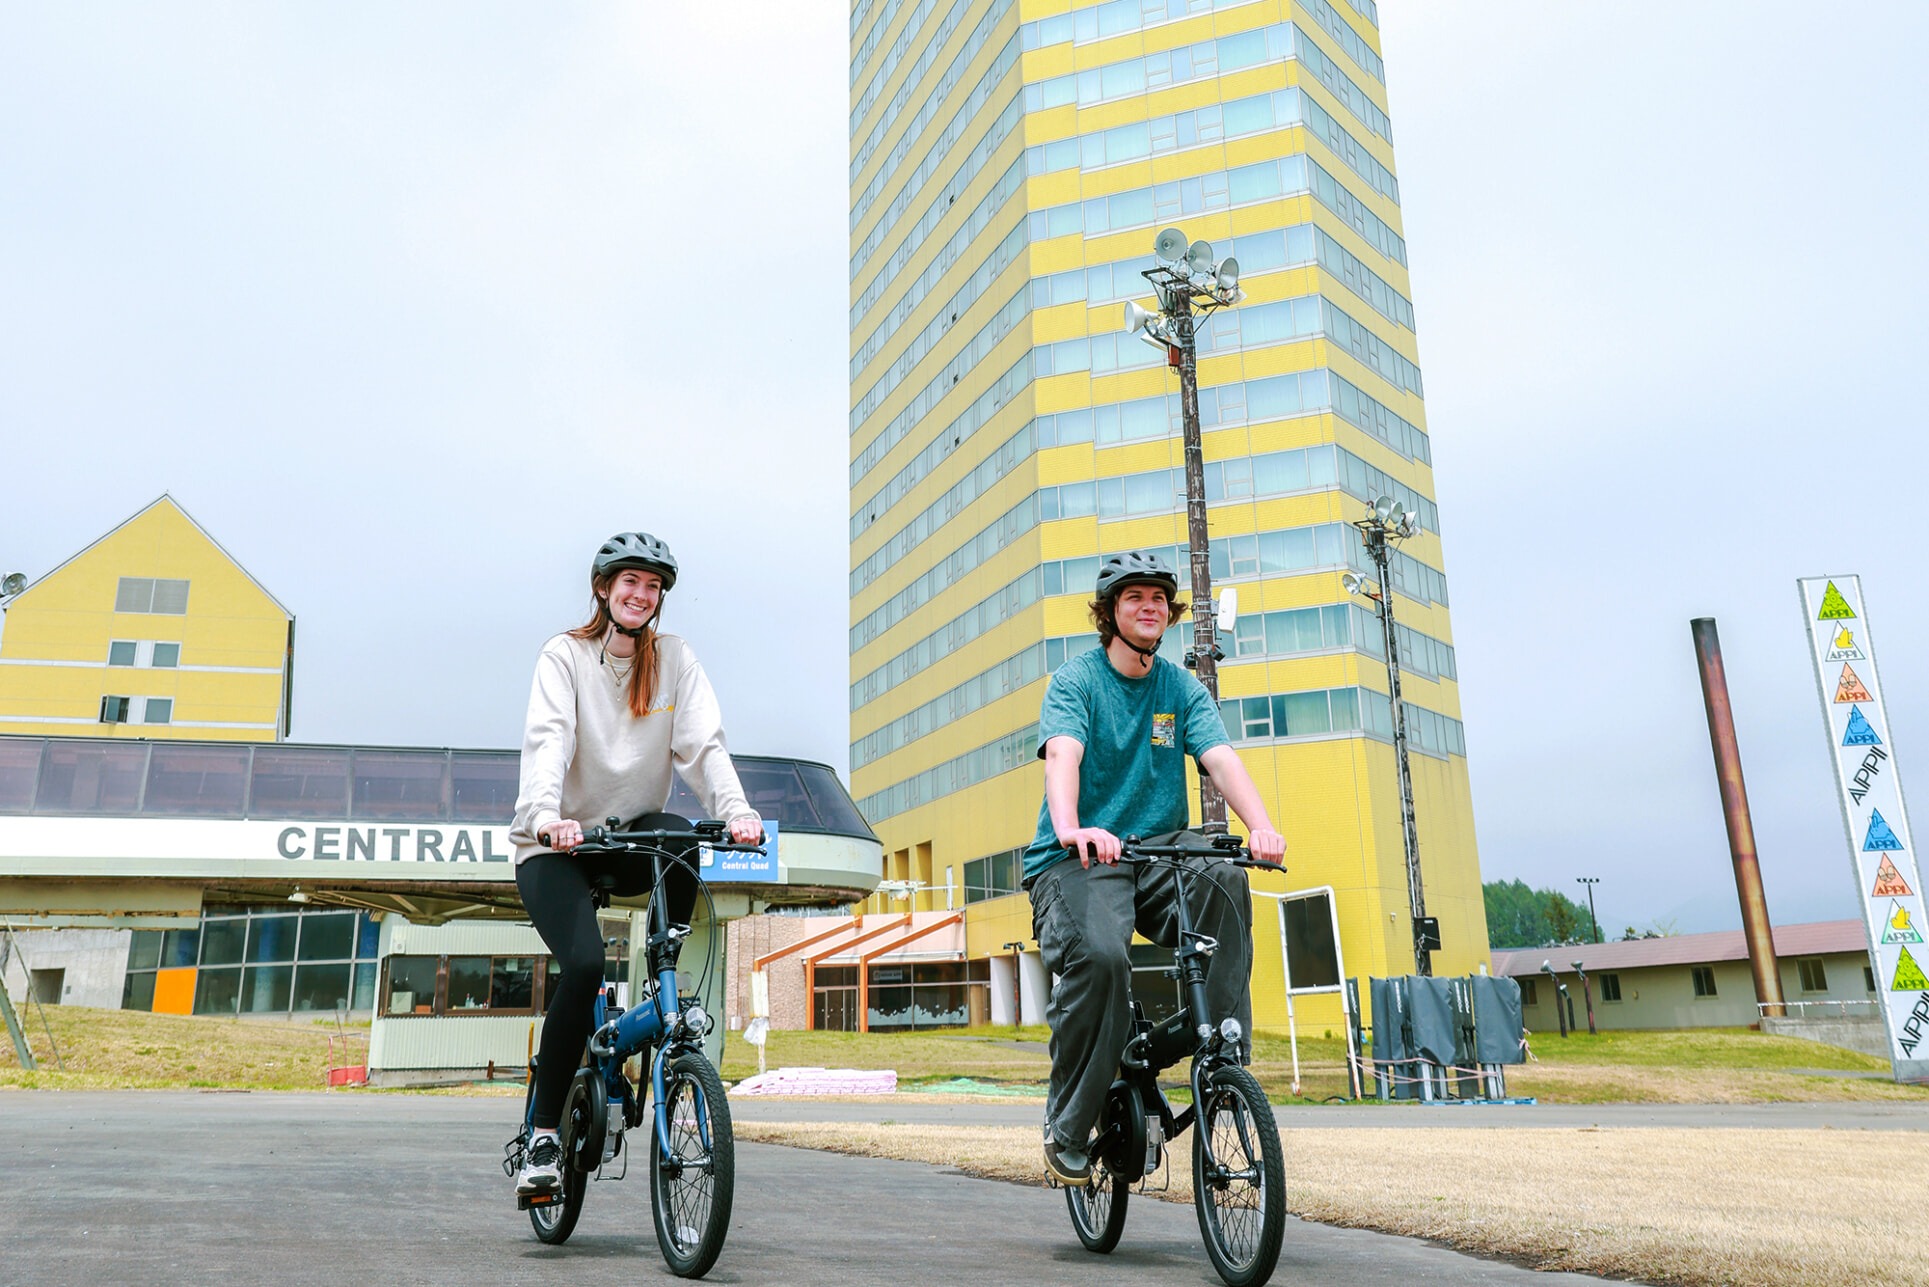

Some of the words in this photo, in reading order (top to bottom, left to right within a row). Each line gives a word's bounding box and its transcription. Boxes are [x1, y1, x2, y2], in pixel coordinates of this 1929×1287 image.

[1822, 609, 1850, 618] APPI
[1830, 650, 1858, 659] APPI
[1838, 691, 1867, 701] APPI
[1846, 735, 1875, 744] APPI
[1848, 745, 1888, 806] APPI
[277, 826, 509, 863] CENTRAL
[1867, 840, 1897, 849] APPI
[722, 861, 749, 870] Central
[750, 861, 769, 870] Quad
[1877, 885, 1906, 895] APPI
[1886, 932, 1916, 942] APPI
[1895, 980, 1926, 989] APPI
